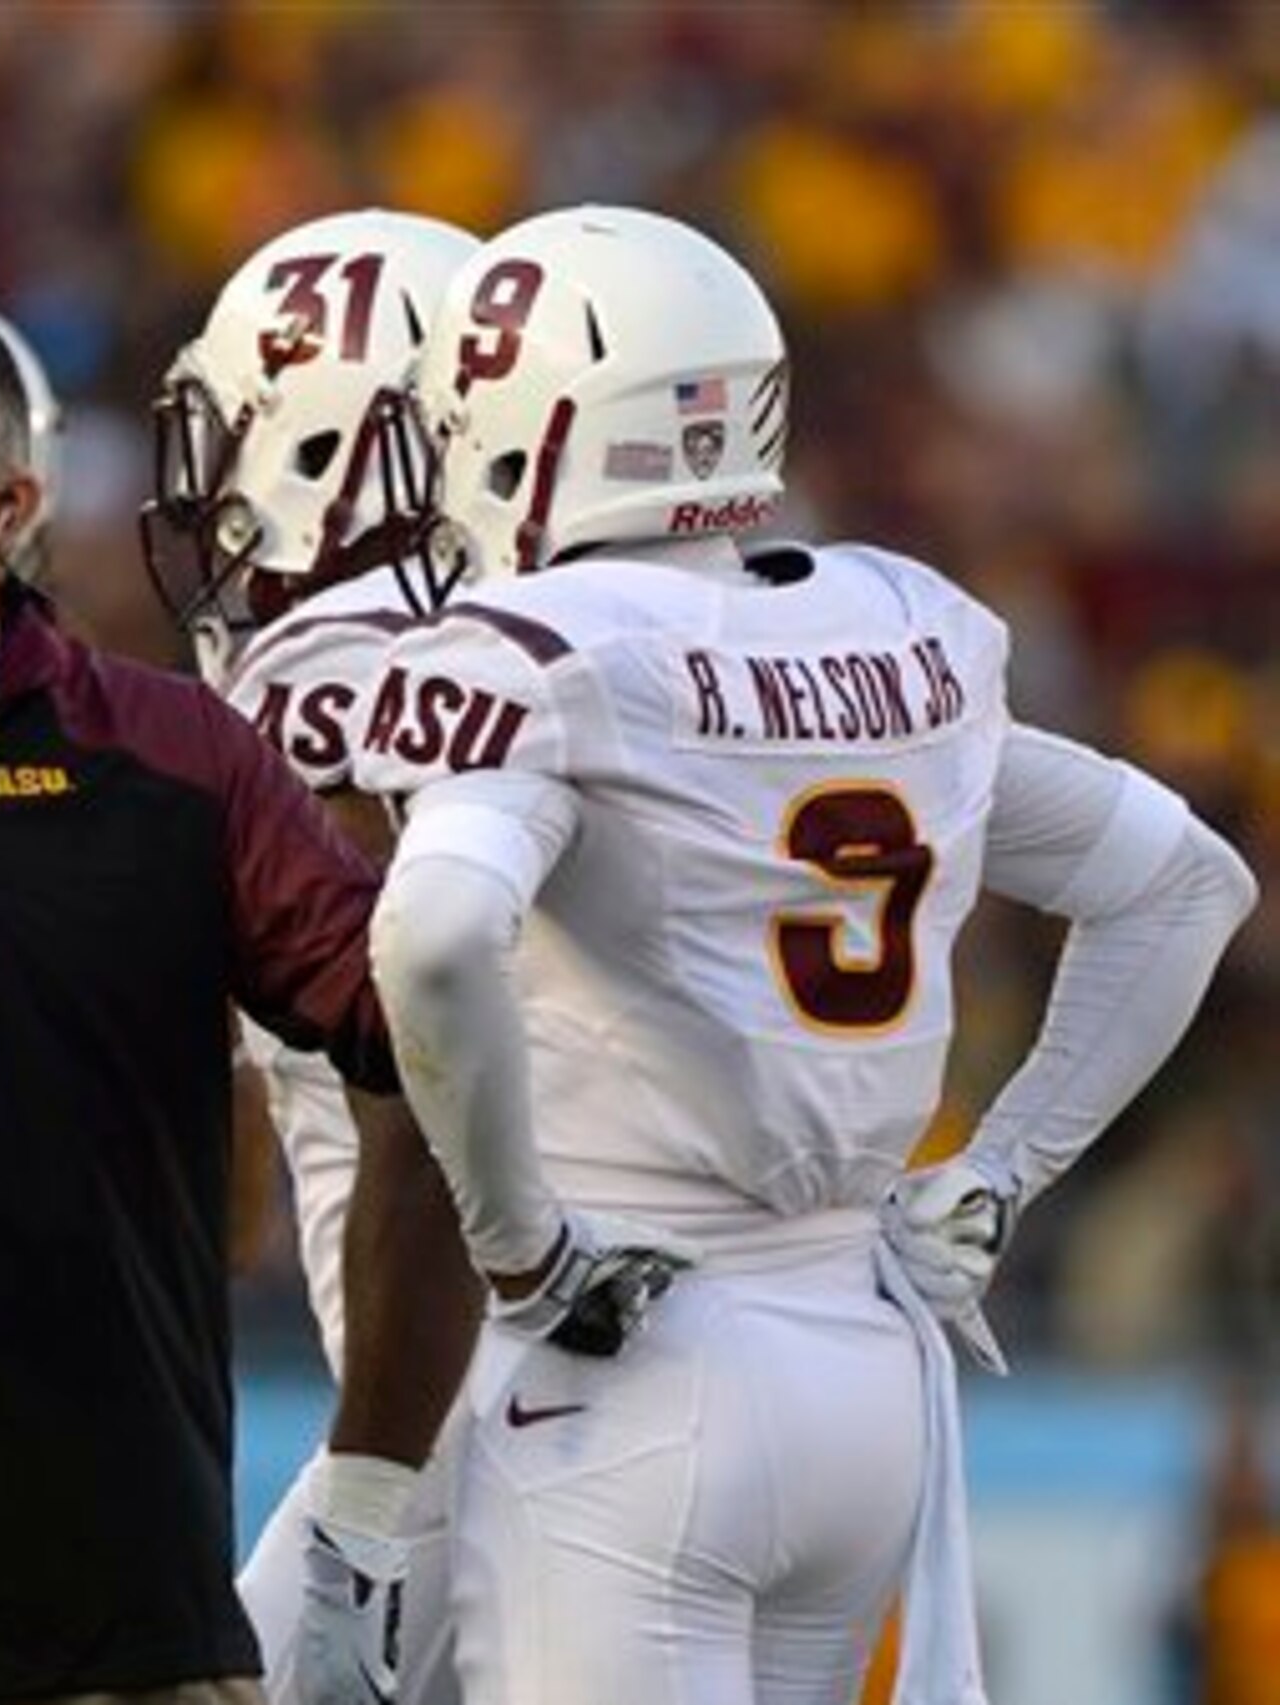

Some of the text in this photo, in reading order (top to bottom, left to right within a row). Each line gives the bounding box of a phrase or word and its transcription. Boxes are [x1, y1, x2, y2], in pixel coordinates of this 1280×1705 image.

[258, 253, 384, 371] 31
[458, 259, 544, 385] 9
[256, 681, 357, 769] AS
[363, 666, 531, 773] ASU
[687, 650, 745, 736] R.
[746, 650, 913, 740] NELSON
[767, 778, 934, 1039] 9
